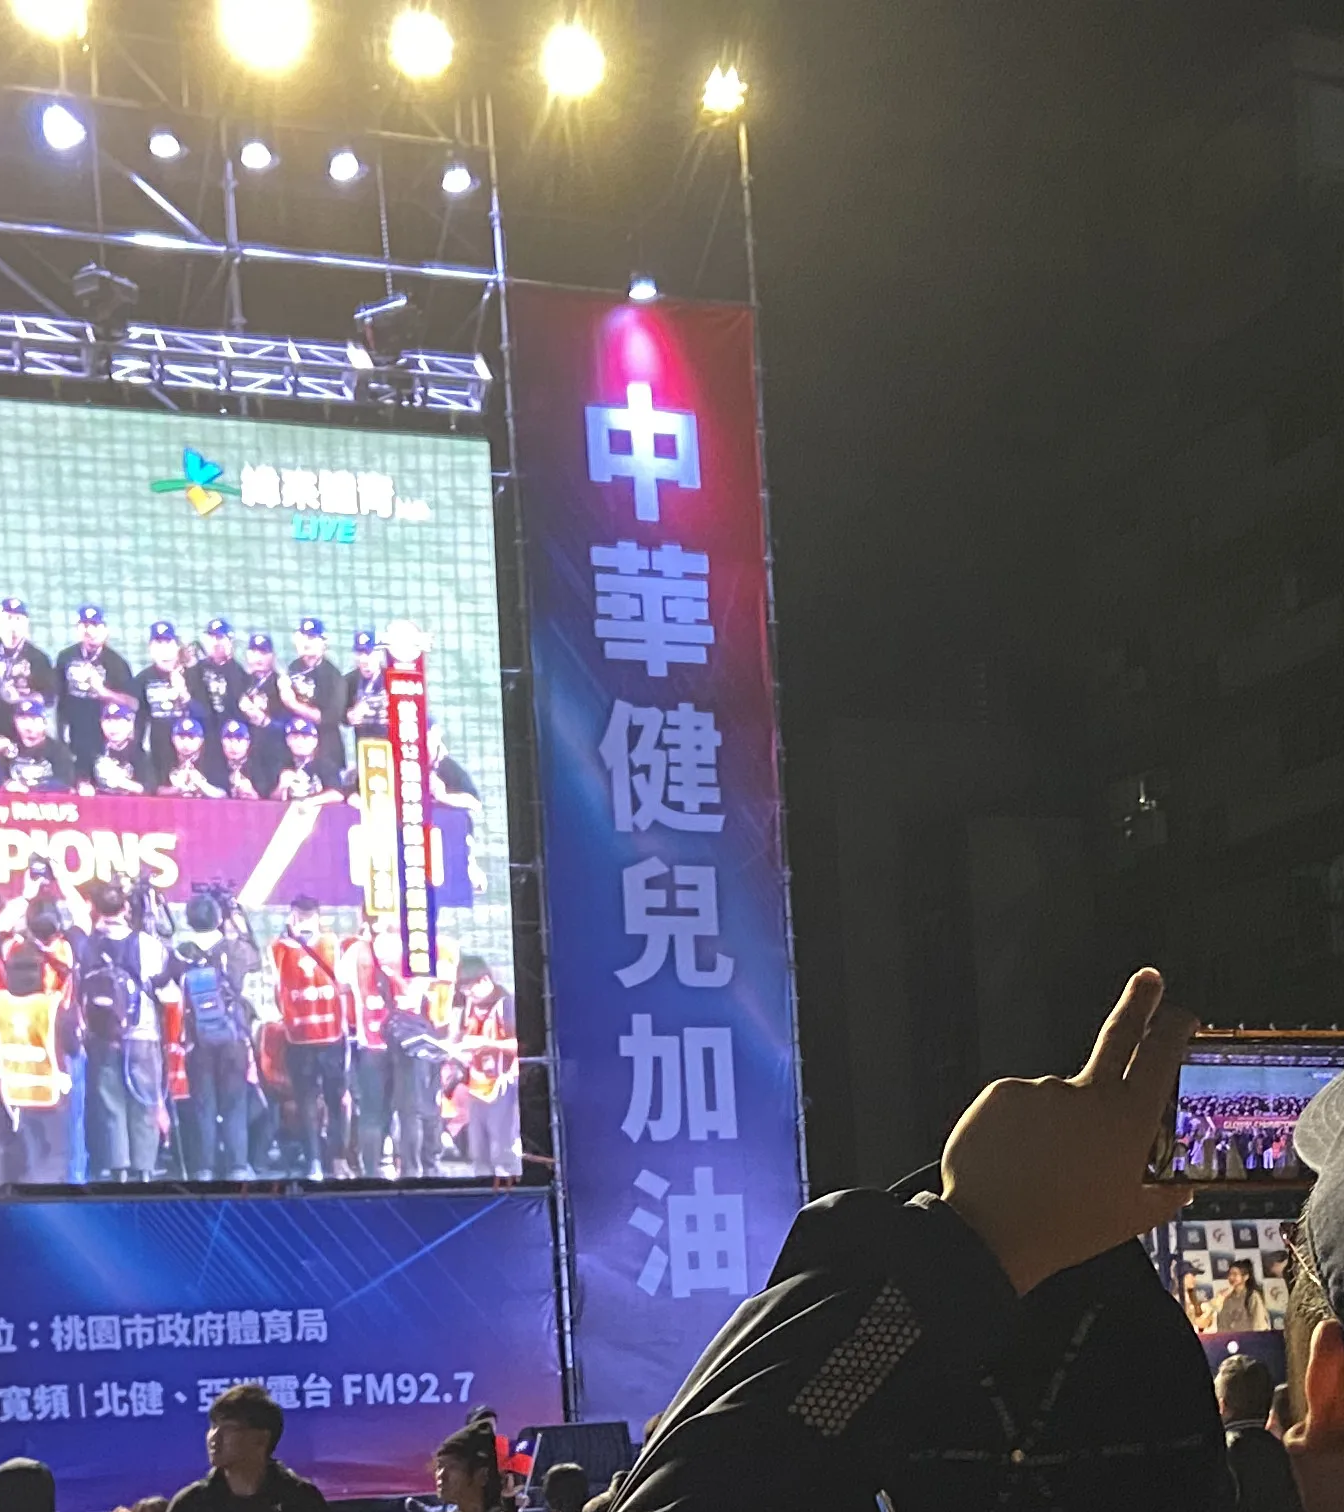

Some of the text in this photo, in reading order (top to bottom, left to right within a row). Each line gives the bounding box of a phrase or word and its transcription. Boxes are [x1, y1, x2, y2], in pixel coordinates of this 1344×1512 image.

[291, 513, 357, 544] LIVE
[584, 380, 749, 1300] 中華健兒加油
[341, 1371, 475, 1406] FM92.7
